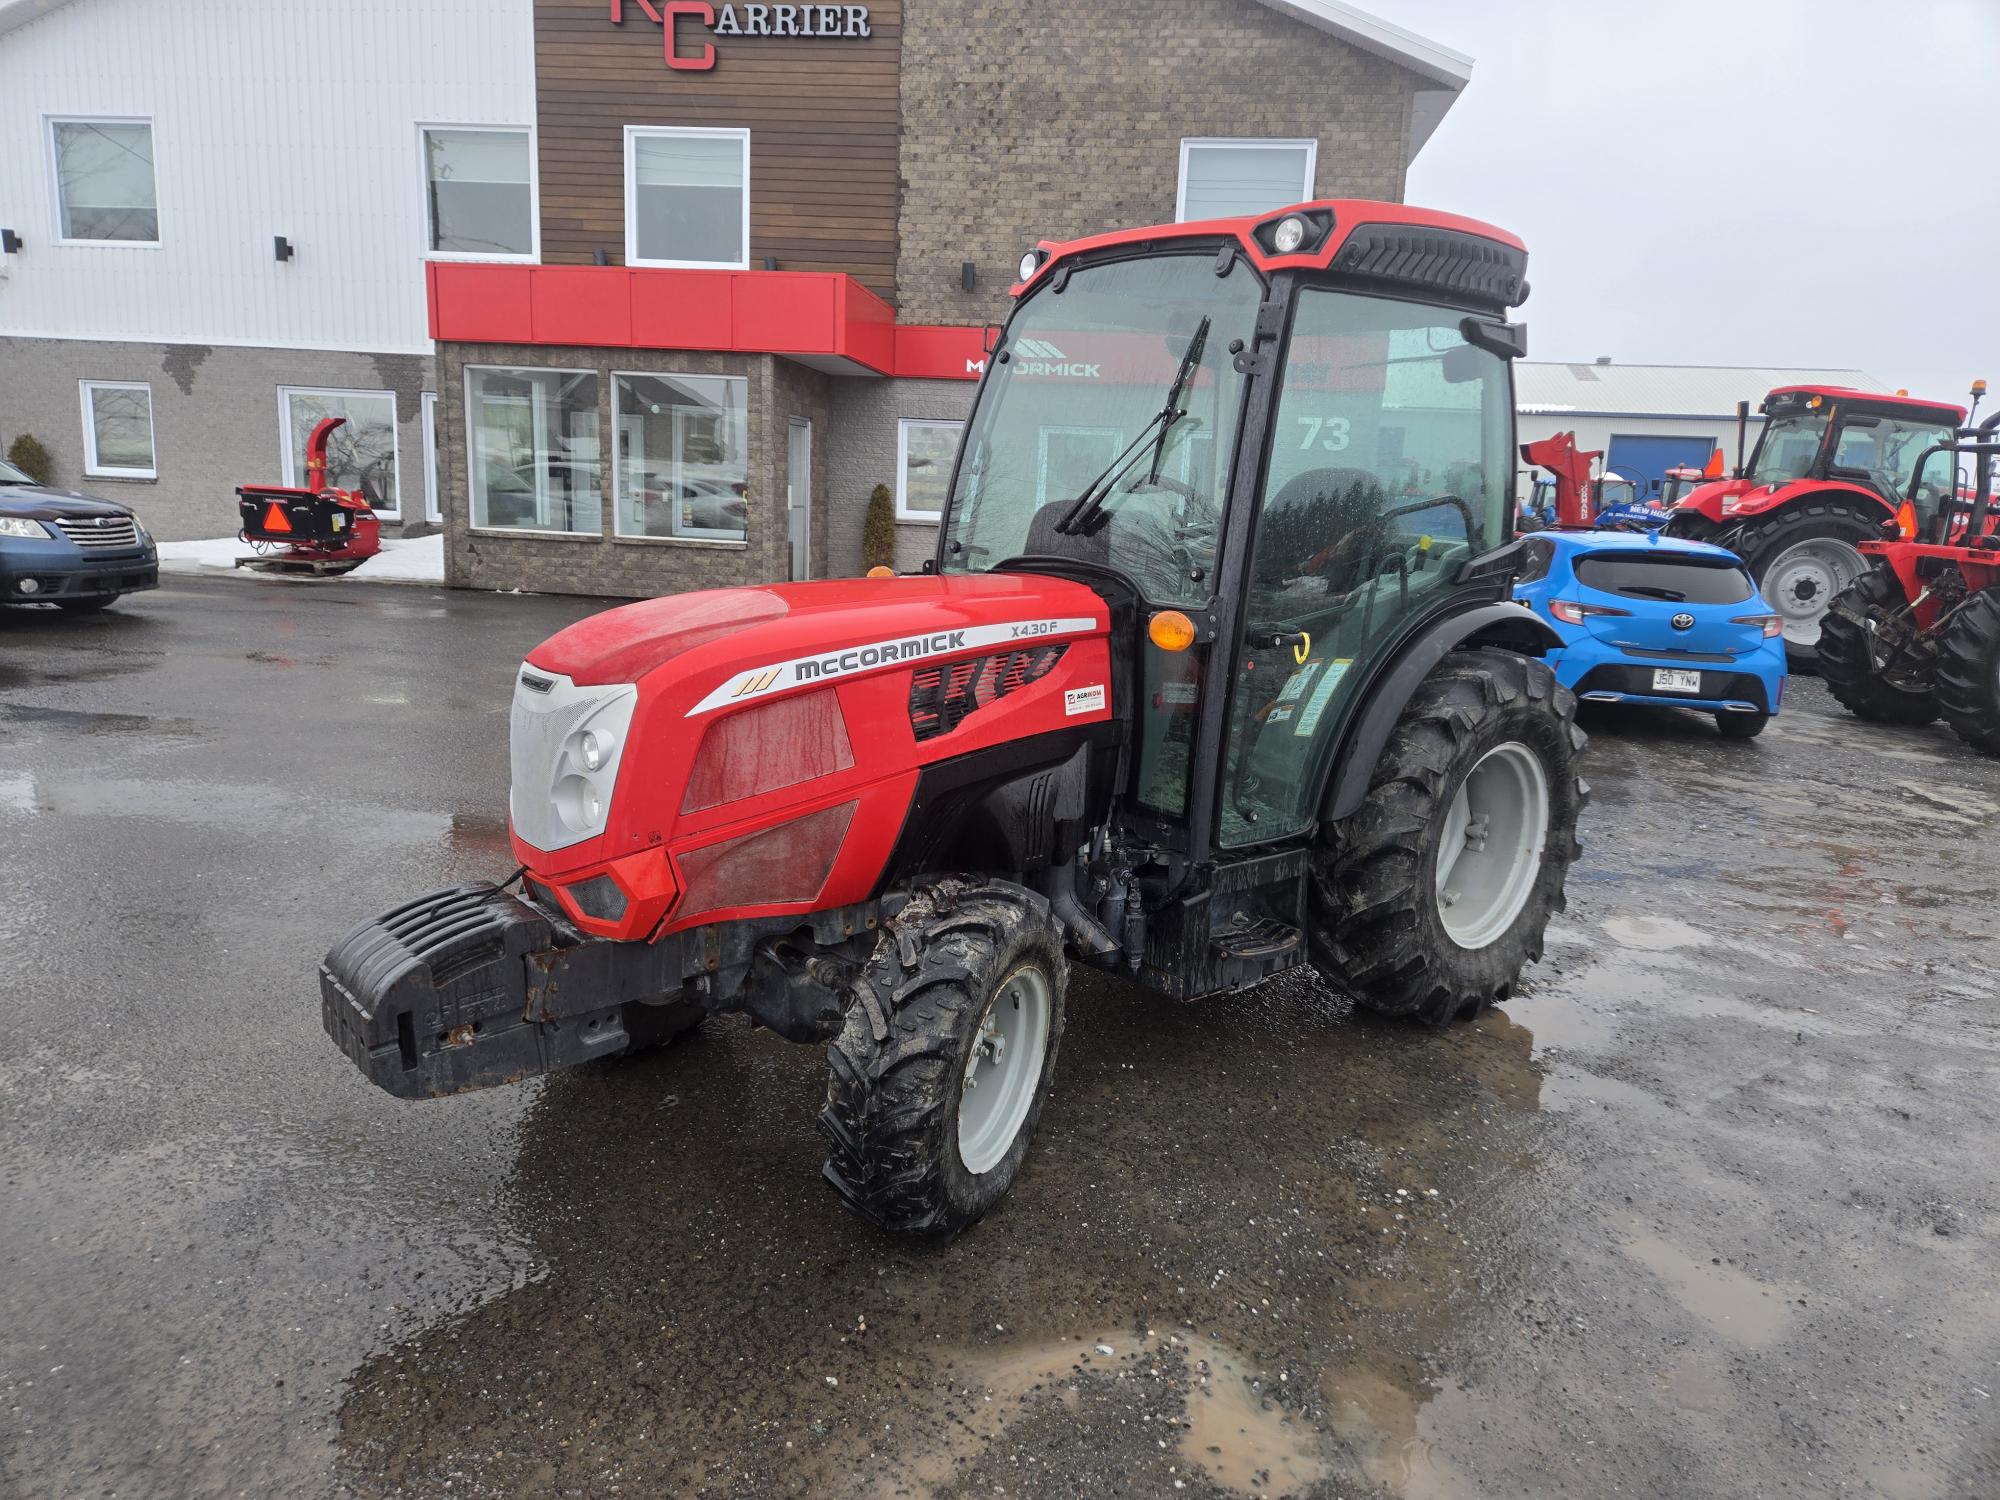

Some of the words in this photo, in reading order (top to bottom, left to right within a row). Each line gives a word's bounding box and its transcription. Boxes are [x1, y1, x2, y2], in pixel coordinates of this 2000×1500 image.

[966, 359, 1100, 377] MORMICK
[1298, 416, 1351, 451] 73
[1630, 506, 1650, 514] NEW
